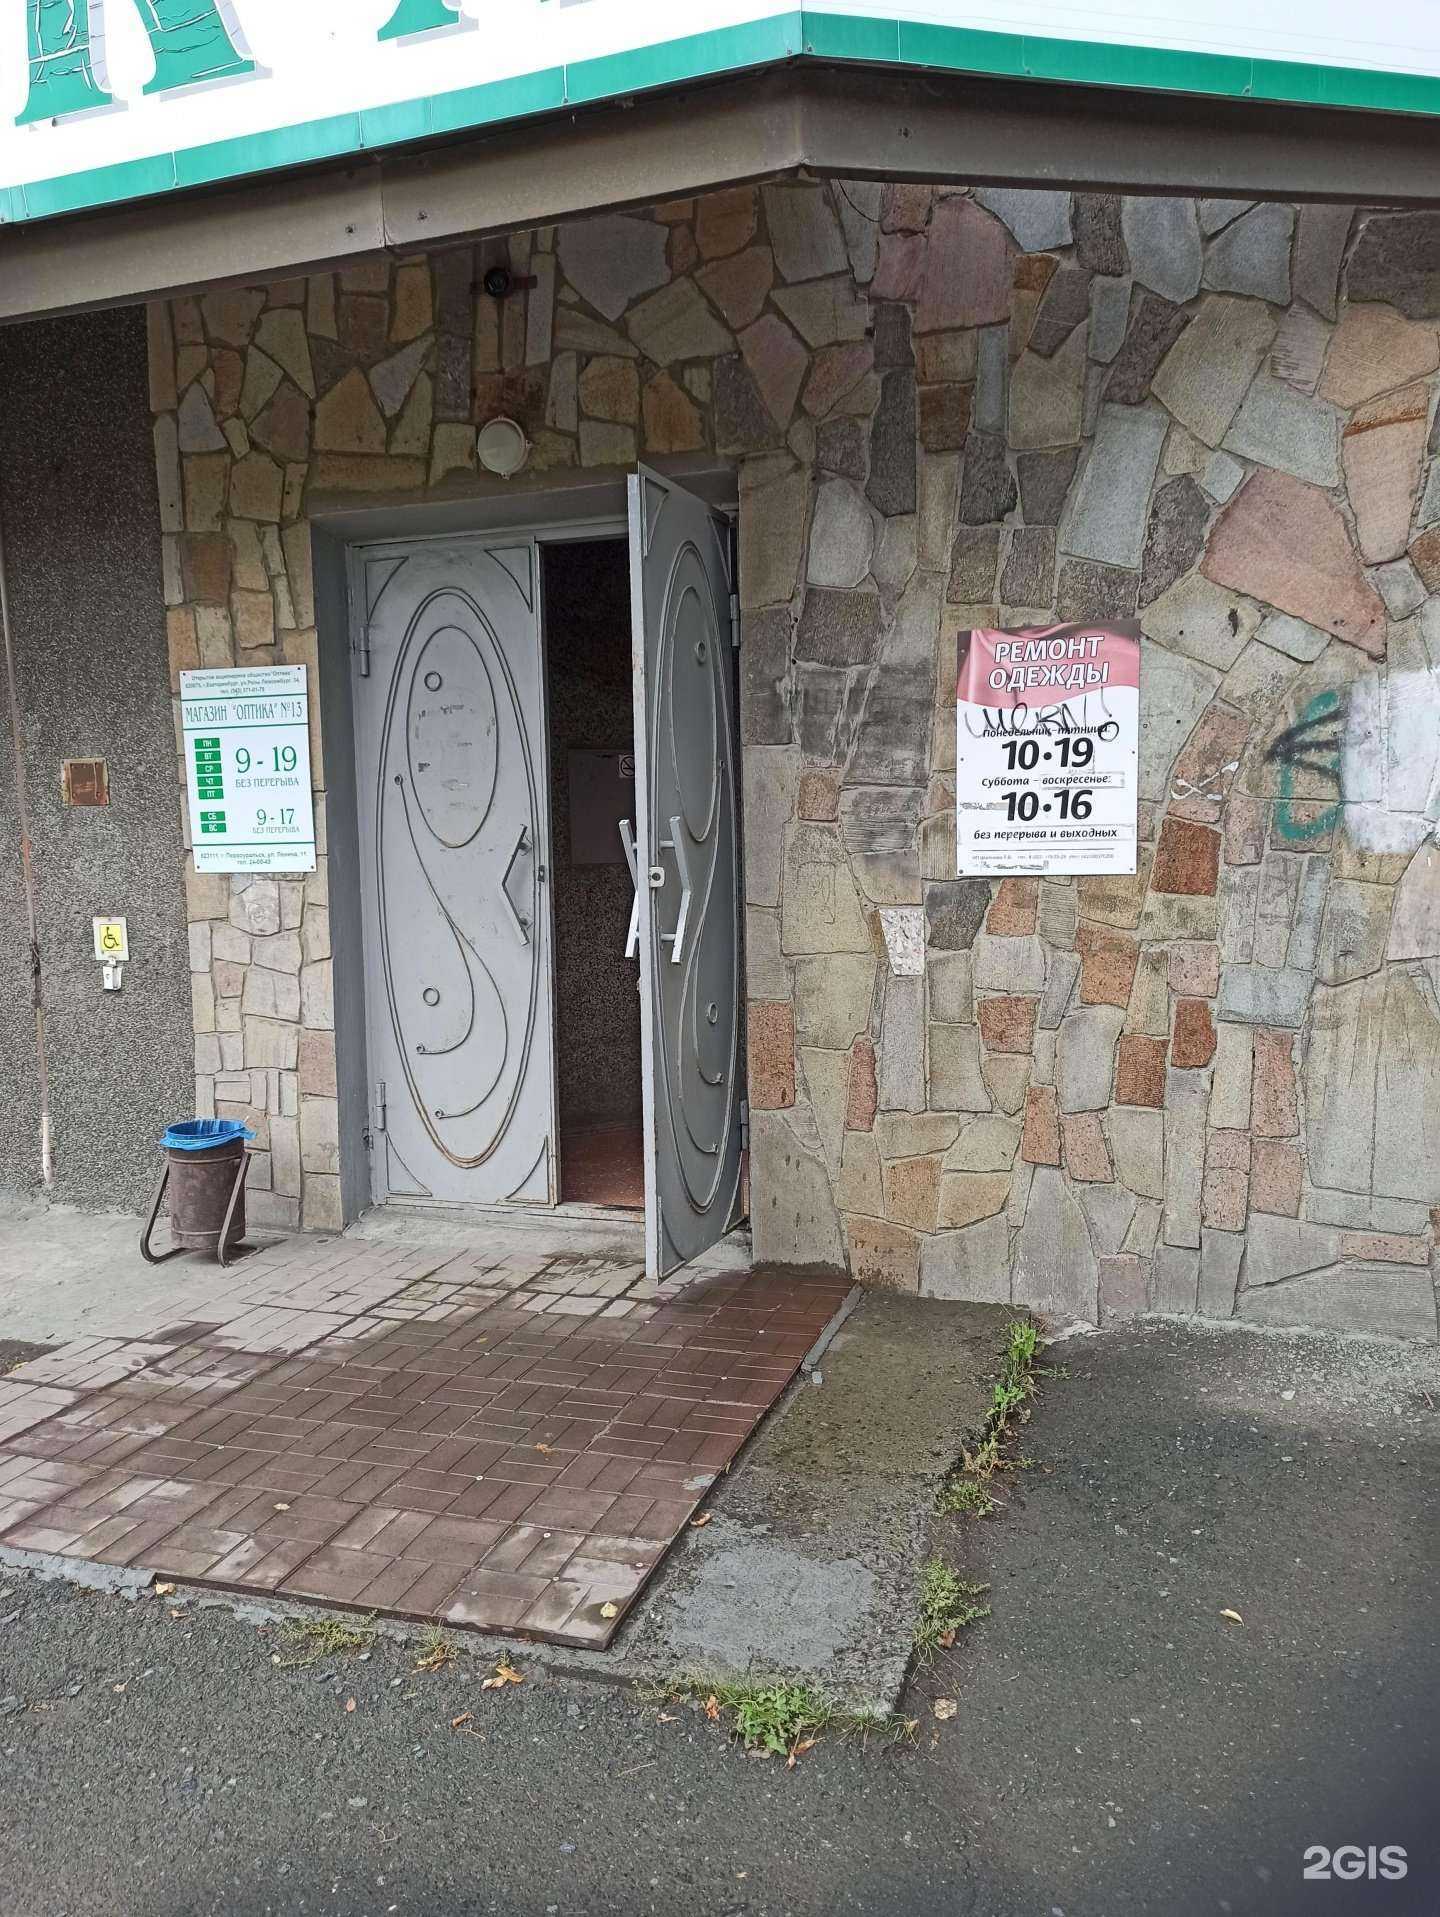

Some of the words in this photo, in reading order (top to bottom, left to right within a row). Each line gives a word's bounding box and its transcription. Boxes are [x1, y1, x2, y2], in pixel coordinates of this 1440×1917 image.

[994, 636, 1105, 664] РЕМОНТ
[988, 662, 1110, 694] ОДЕЖДЫ
[185, 705, 228, 722] МАГАЗИН
[235, 747, 251, 774] 9
[272, 745, 297, 772] 19
[235, 779, 252, 788] БЕЗ
[253, 777, 300, 788] ПЕРЕРЫВА
[1042, 775, 1112, 787] воскресенье:
[207, 790, 215, 798] ПТ
[256, 808, 267, 826] 9
[280, 808, 295, 825] 17
[973, 830, 991, 839] без
[994, 829, 1047, 841] перерыва
[1050, 829, 1057, 838] и
[1060, 828, 1118, 838] выходных
